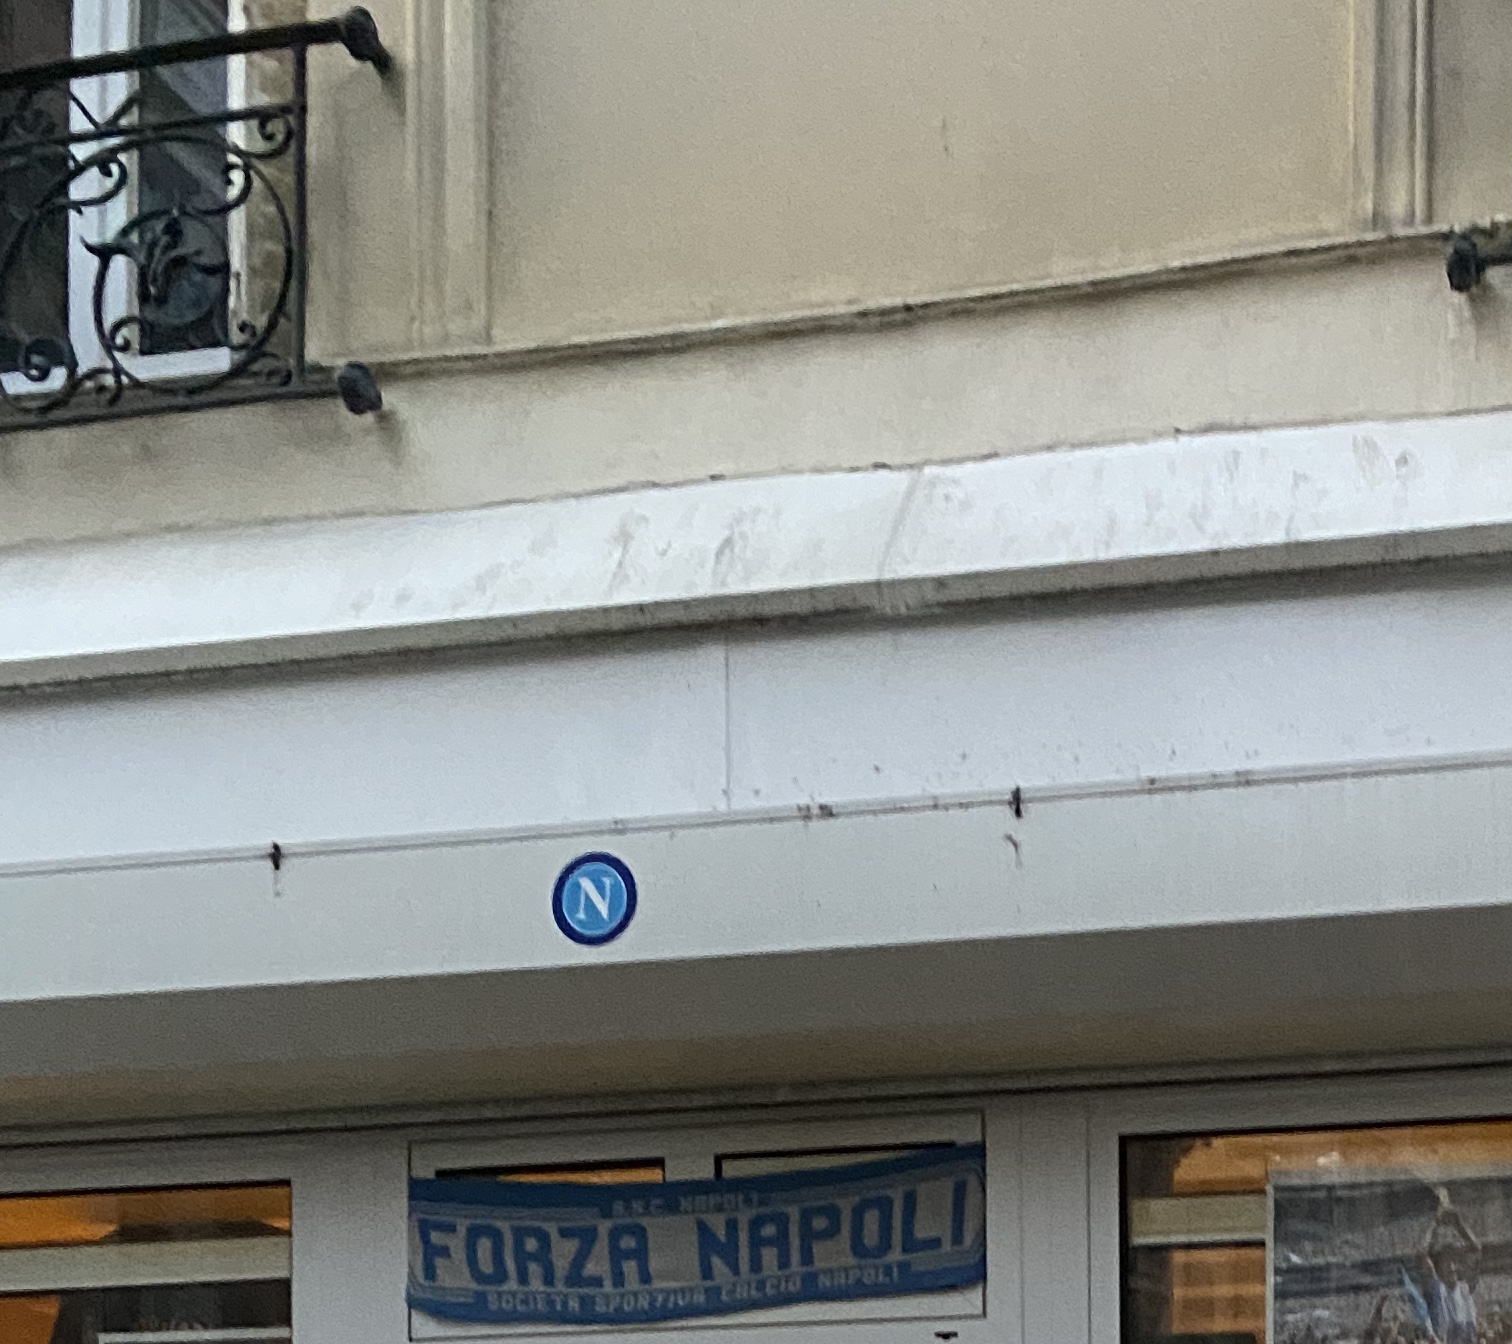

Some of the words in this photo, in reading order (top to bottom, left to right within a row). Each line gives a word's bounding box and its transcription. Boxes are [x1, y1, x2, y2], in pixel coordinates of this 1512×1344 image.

[574, 876, 614, 922] N
[417, 1217, 651, 1289] FORZA
[696, 1179, 968, 1284] NAPOLI
[817, 1264, 900, 1290] NAPOLI
